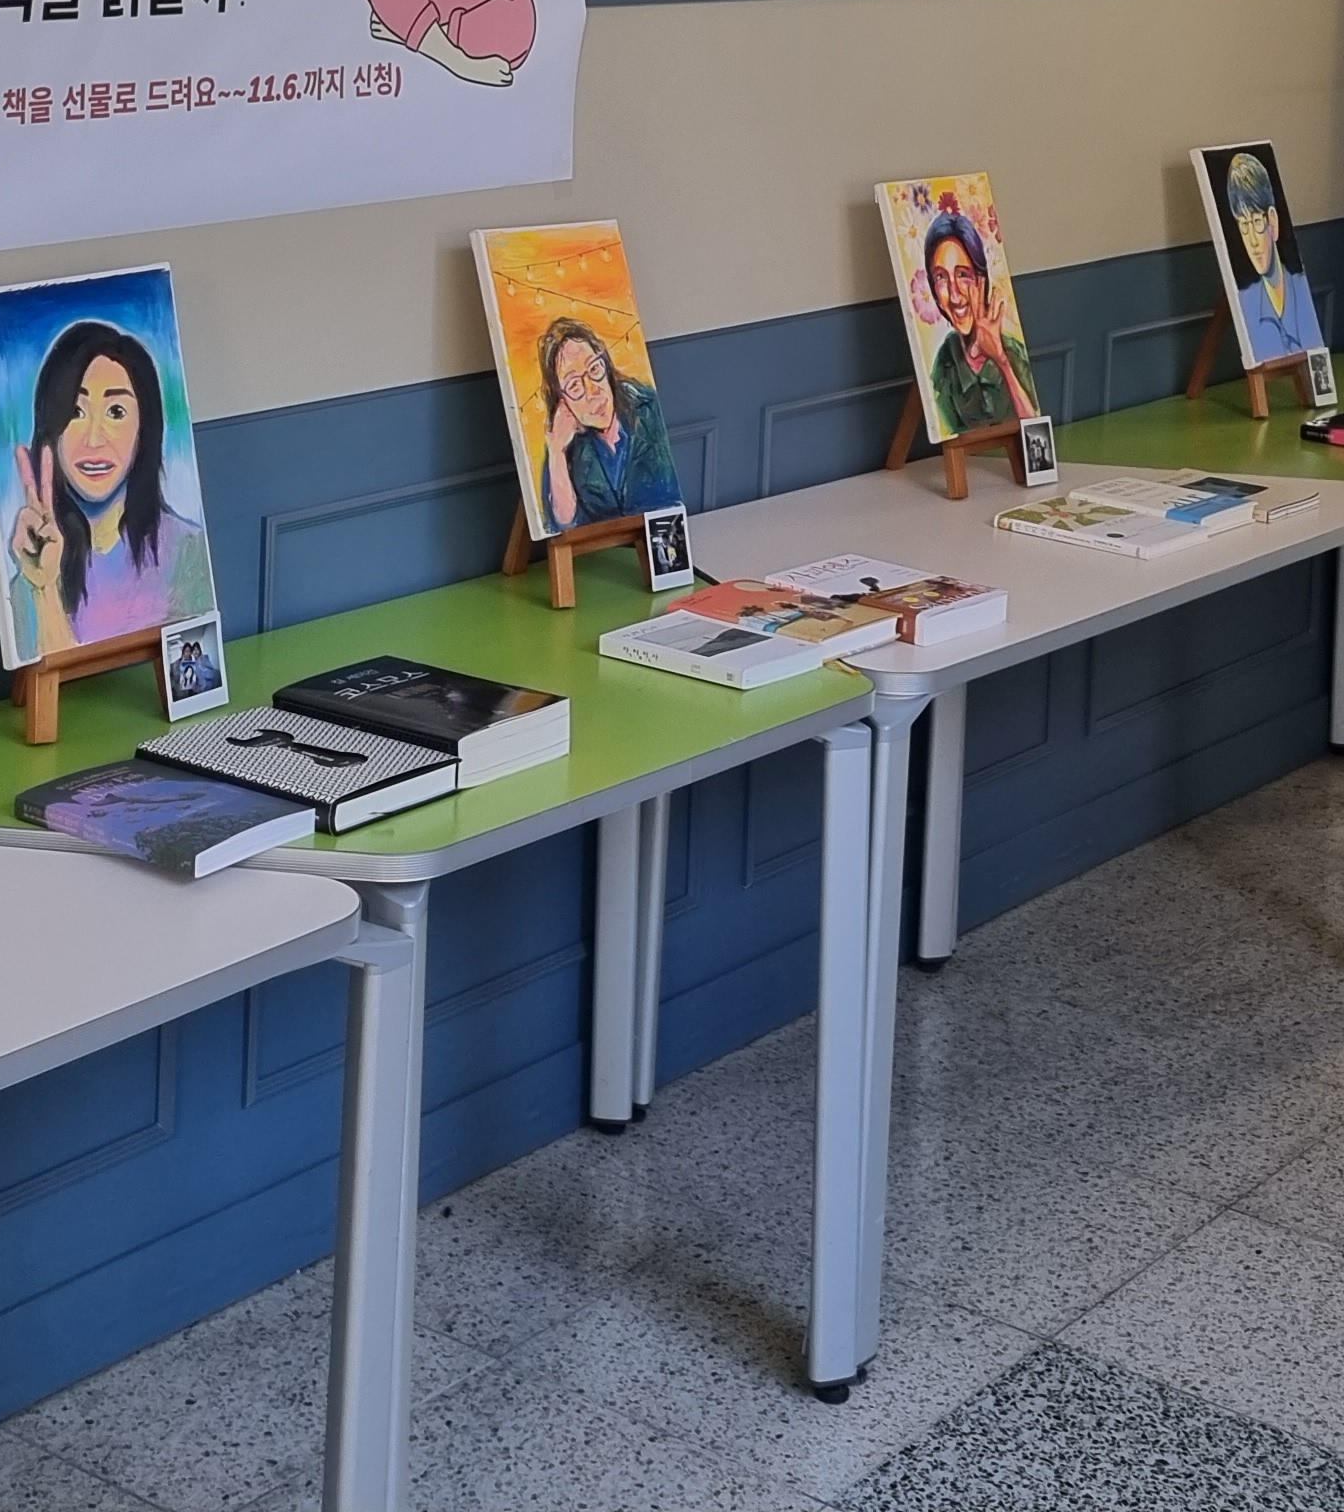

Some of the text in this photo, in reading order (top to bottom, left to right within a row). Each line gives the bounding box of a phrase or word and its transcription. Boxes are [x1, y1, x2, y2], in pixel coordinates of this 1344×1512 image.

[2, 88, 55, 125] 책을
[61, 81, 138, 120] 선물로
[351, 62, 404, 100] 신청)
[333, 670, 430, 701] 코스모스
